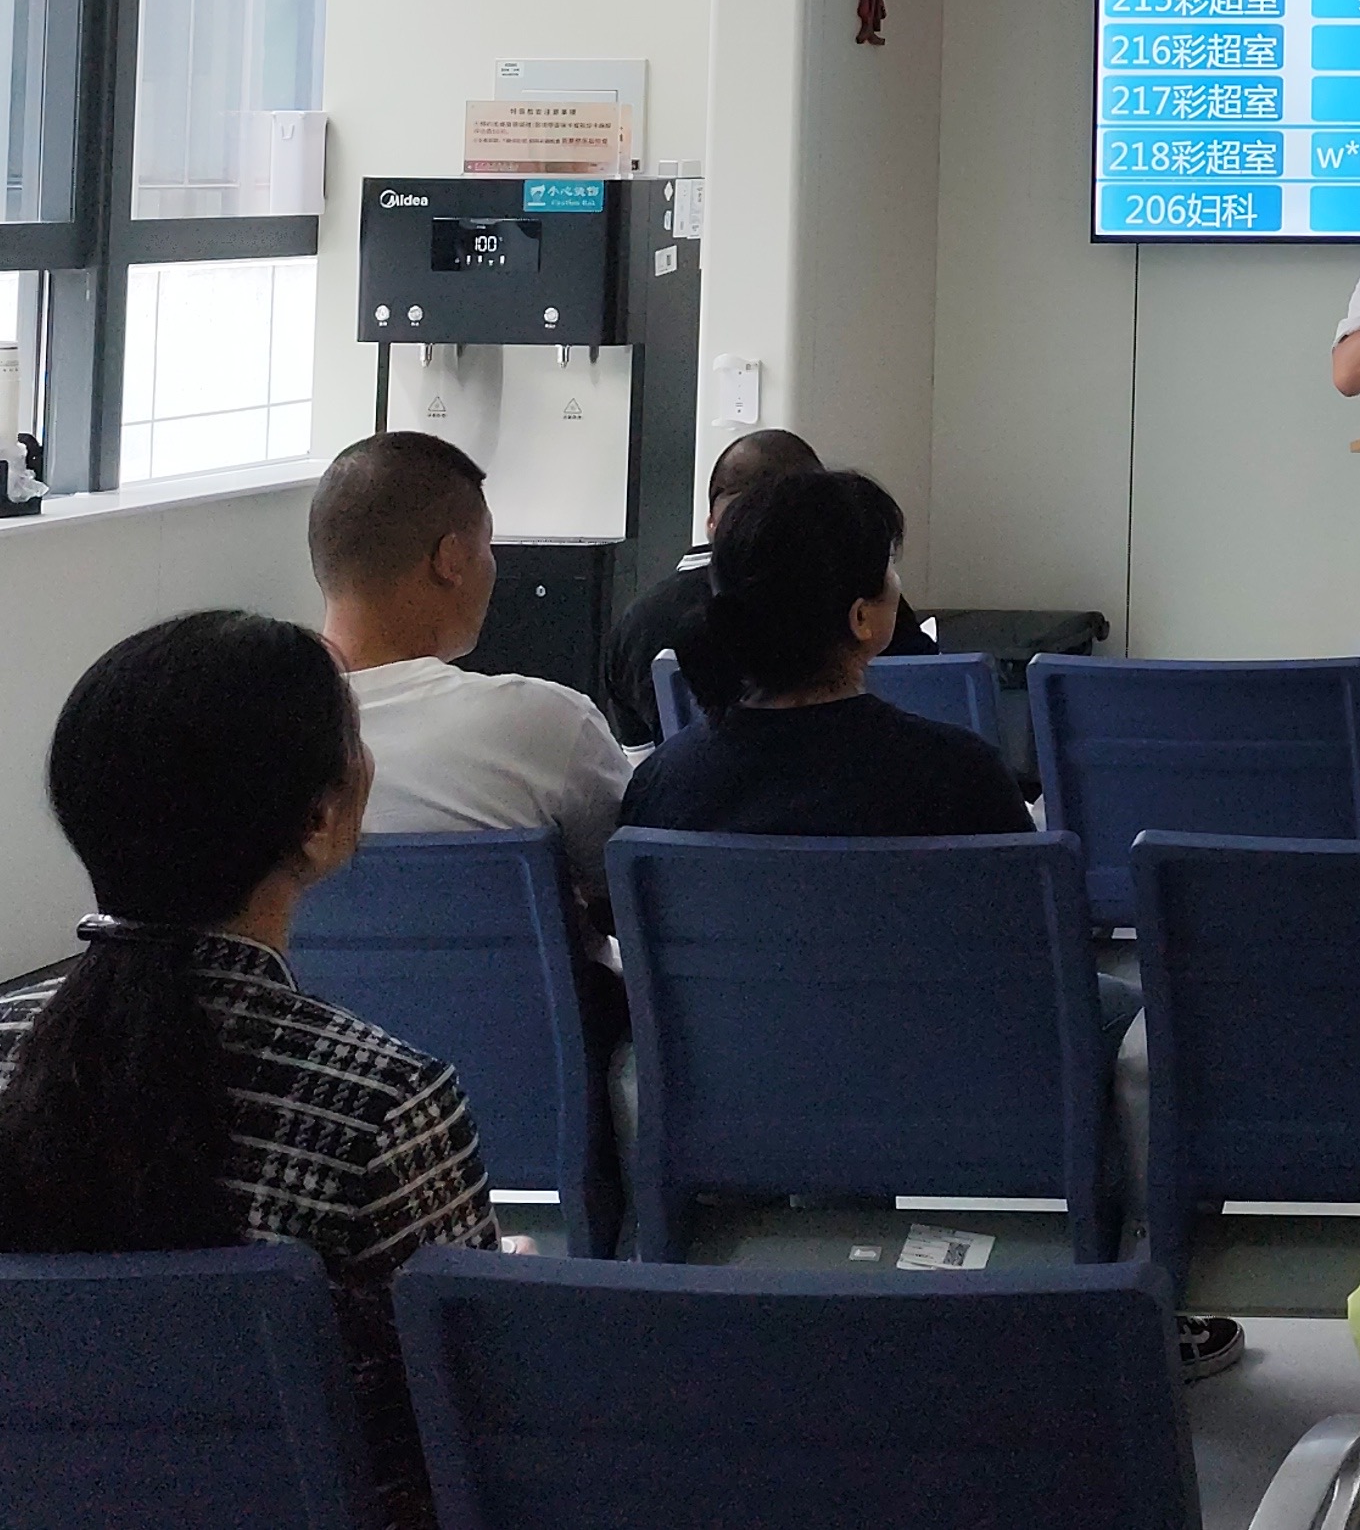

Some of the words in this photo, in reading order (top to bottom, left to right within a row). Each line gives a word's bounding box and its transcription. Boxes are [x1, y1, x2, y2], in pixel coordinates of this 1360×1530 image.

[1110, 33, 1278, 69] 216彩超室
[1110, 84, 1279, 120] 217彩超室
[1109, 139, 1278, 176] 218彩超室
[380, 189, 429, 209] Midea
[1124, 192, 1258, 229] 206妇科
[475, 235, 498, 253] 100
